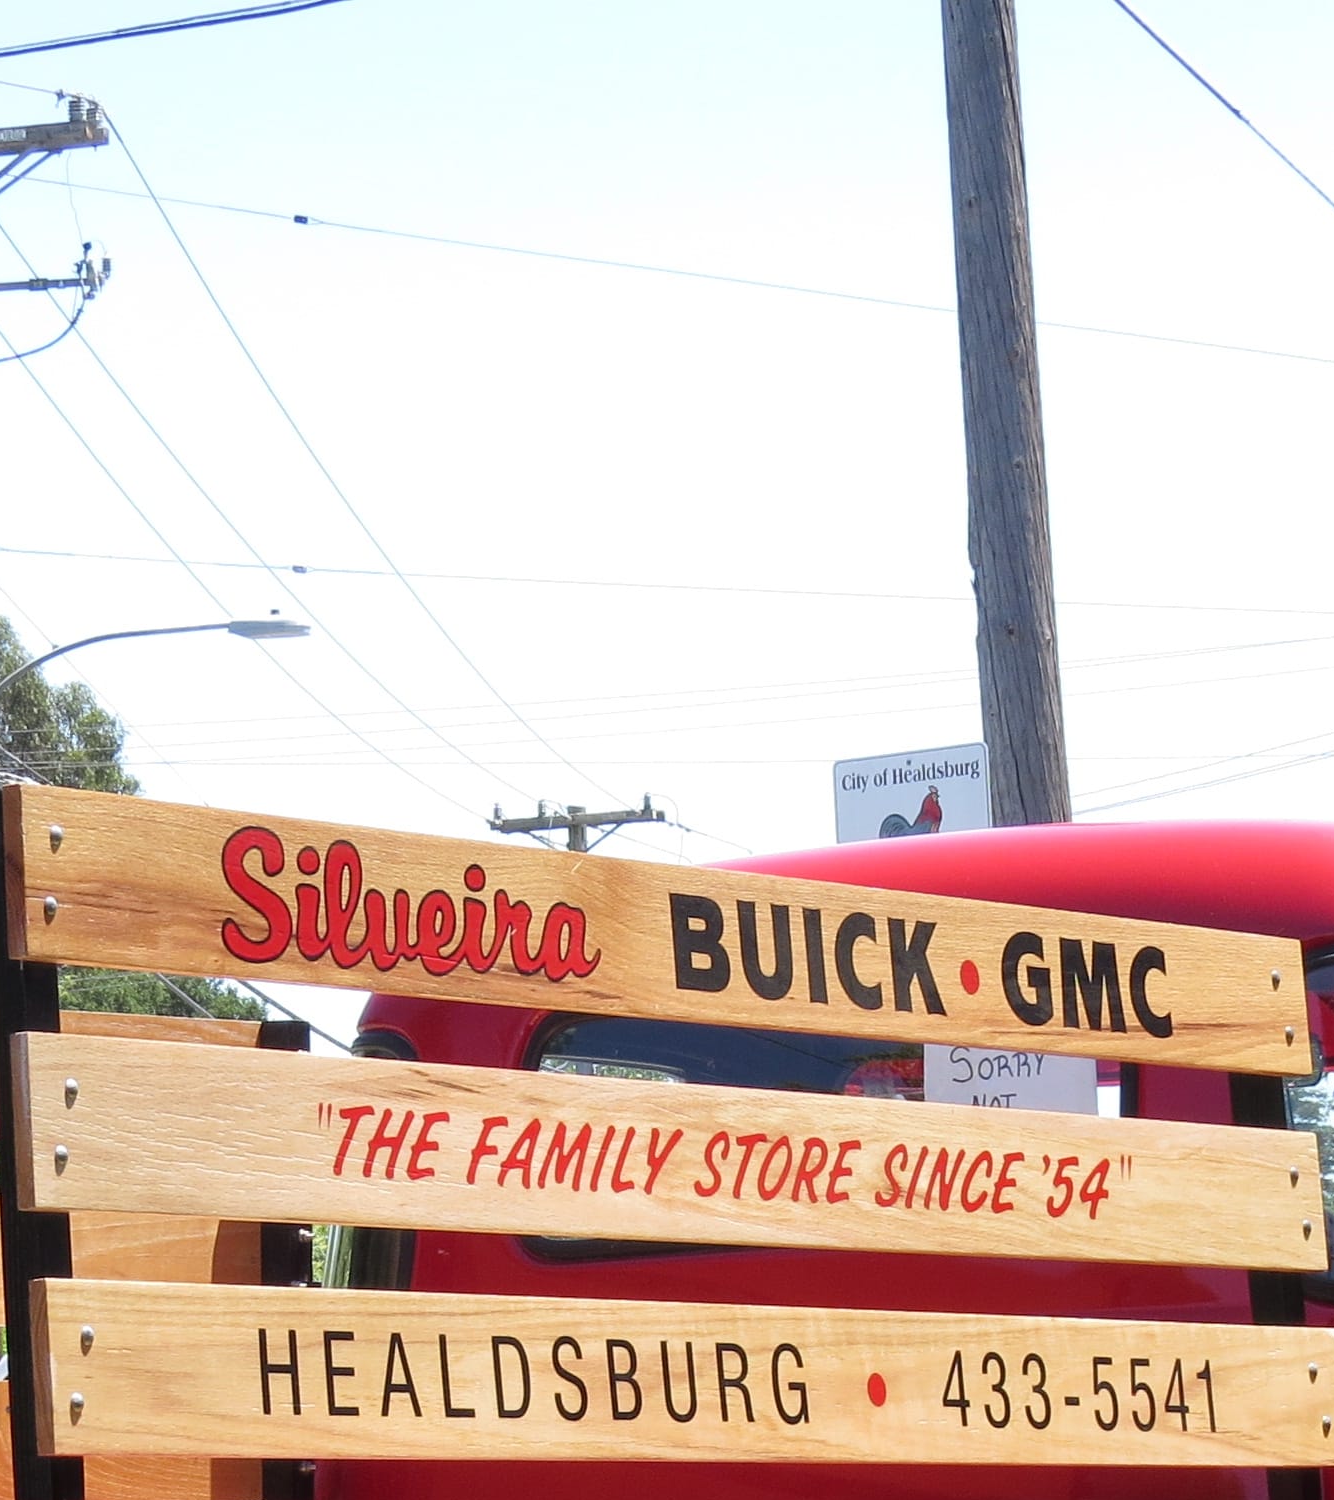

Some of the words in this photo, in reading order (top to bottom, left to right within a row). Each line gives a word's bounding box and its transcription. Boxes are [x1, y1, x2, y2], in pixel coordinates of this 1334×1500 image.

[842, 772, 868, 793] City
[873, 768, 888, 787] of
[892, 759, 981, 785] Healdsburg
[221, 825, 601, 982] Silveira
[670, 894, 947, 1016] BUICK
[1001, 931, 1174, 1039] GMC
[949, 1046, 1045, 1083] SORRY
[317, 1102, 450, 1180] "THE
[466, 1116, 683, 1196] FAMILY
[694, 1131, 862, 1204] STORE
[874, 1143, 1024, 1214] SINCE
[258, 1328, 809, 1425] HEALDSBURG
[942, 1350, 1216, 1434] 433-5541
